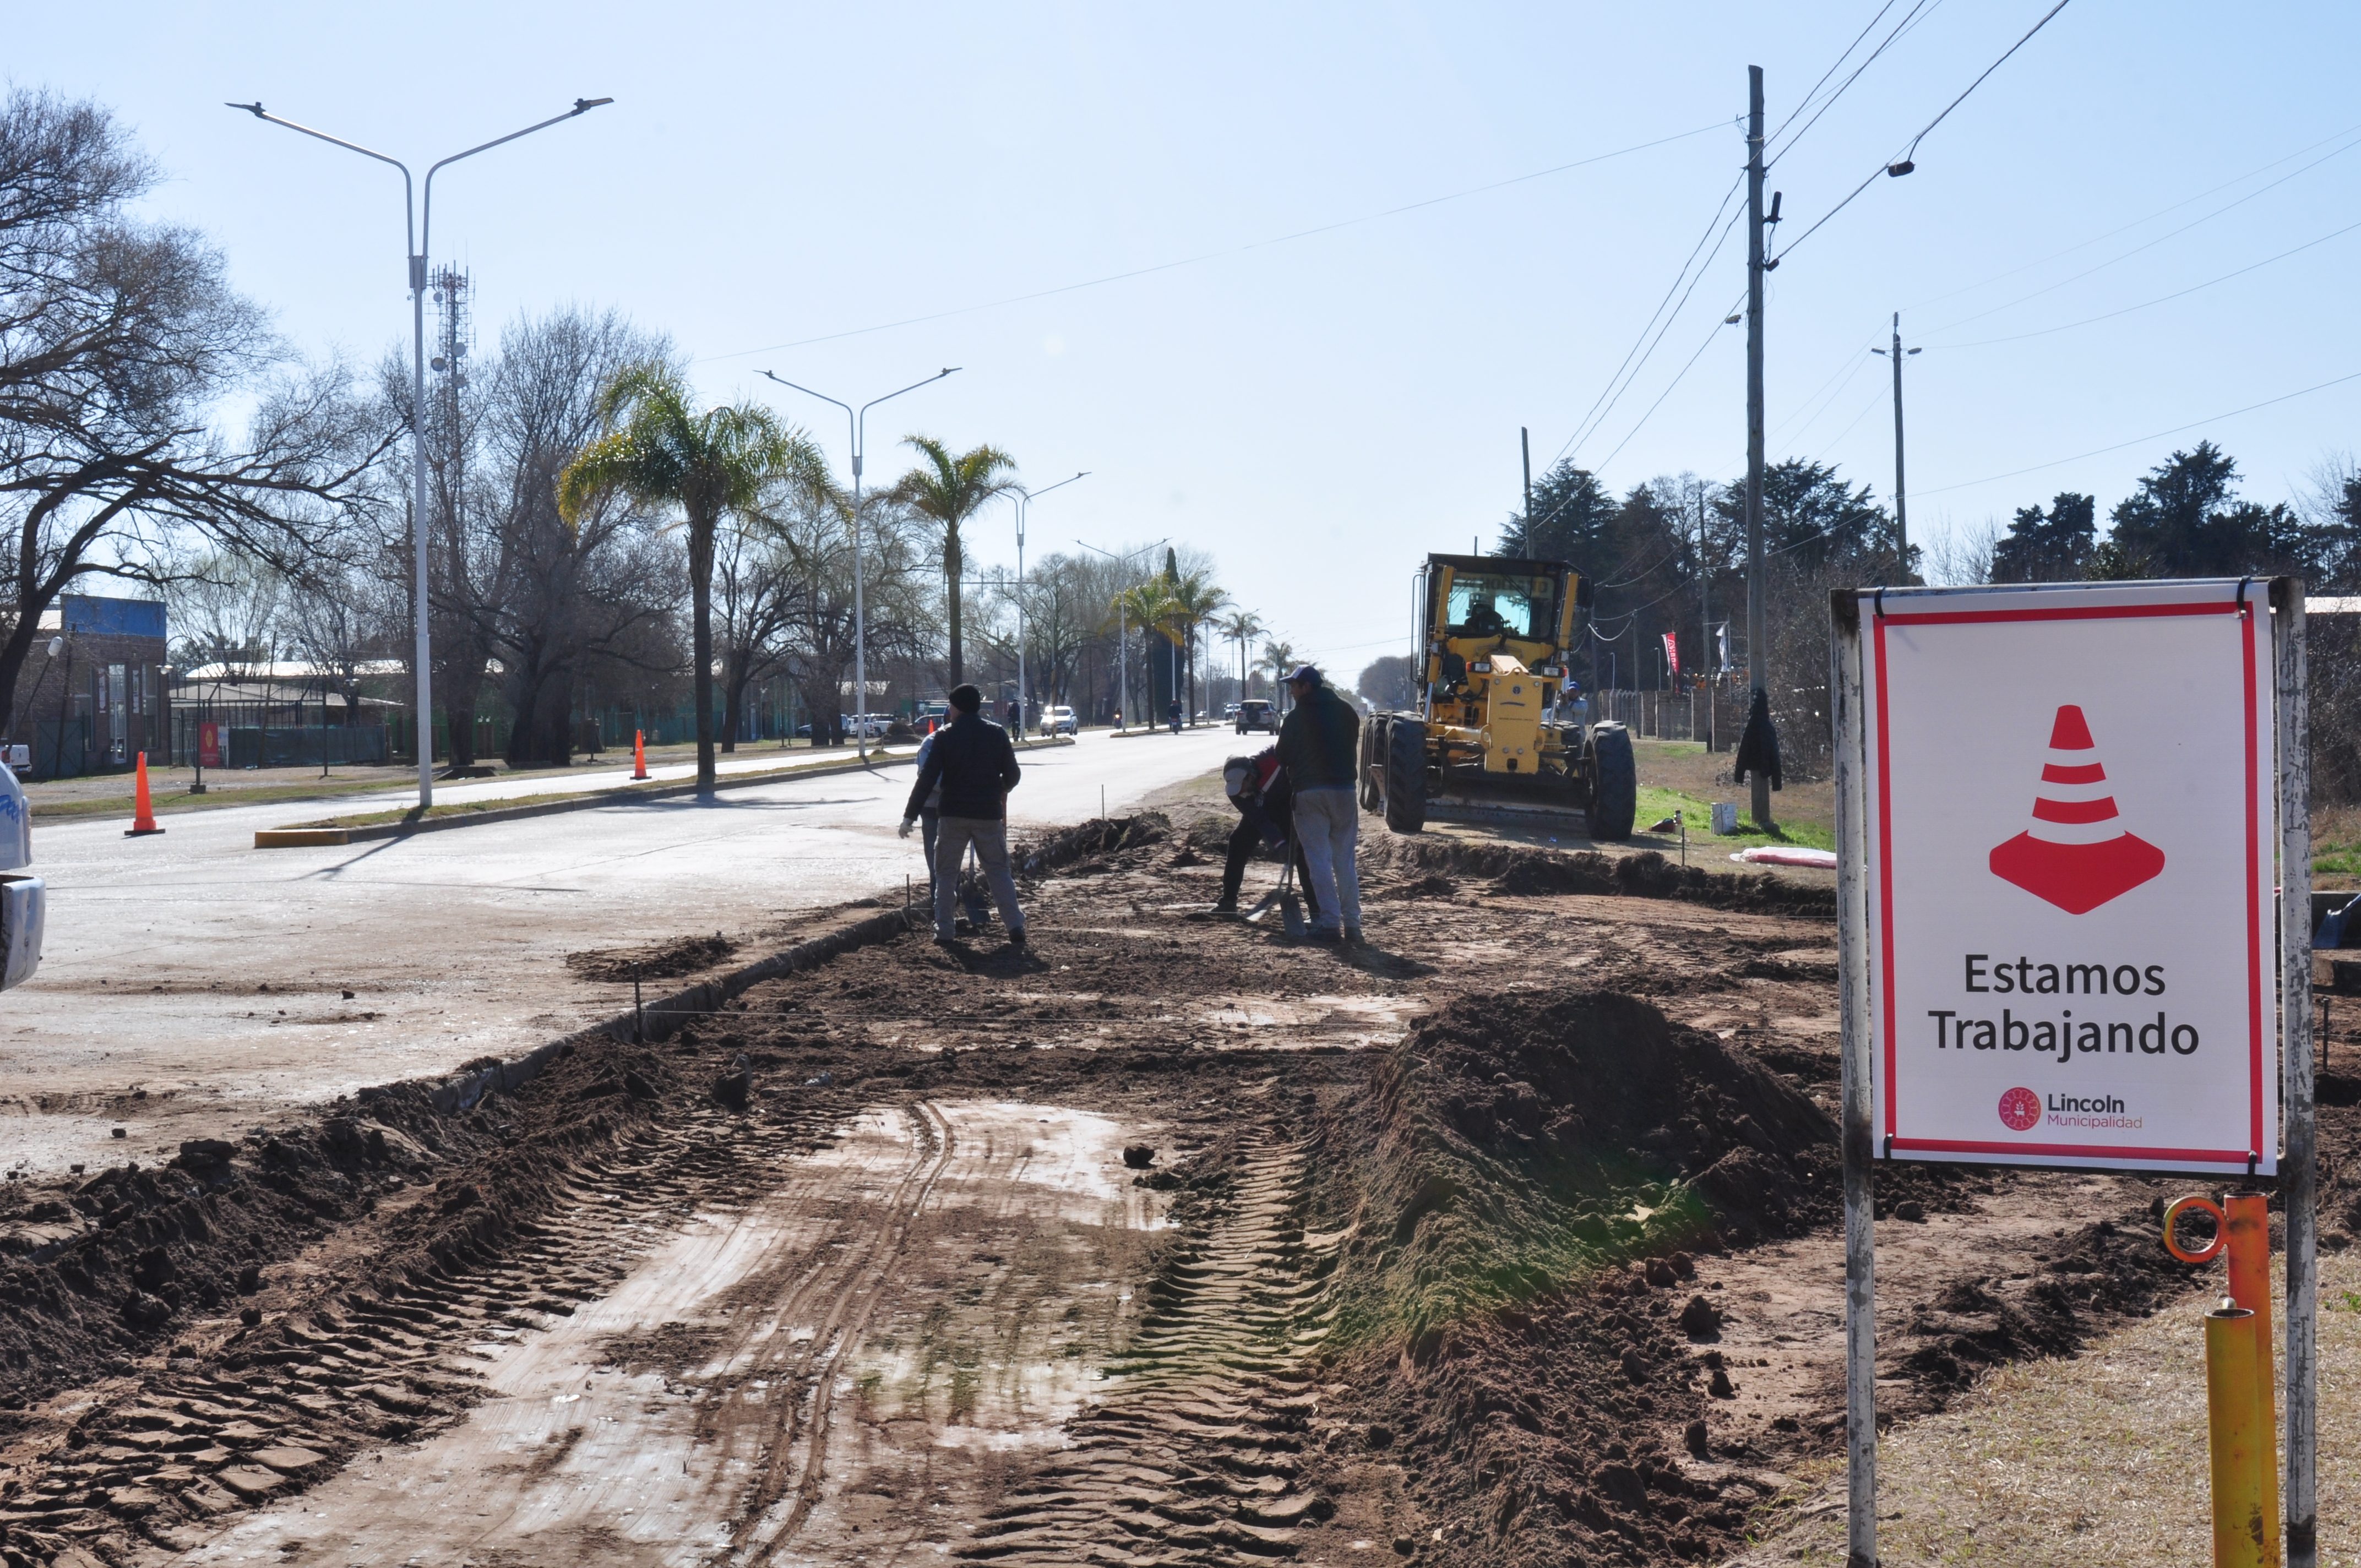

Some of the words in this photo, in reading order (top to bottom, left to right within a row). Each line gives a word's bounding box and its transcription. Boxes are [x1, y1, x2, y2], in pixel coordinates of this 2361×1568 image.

[1965, 954, 2166, 995] Estamos
[1928, 1009, 2199, 1063] Trabajando
[2048, 1093, 2125, 1113] Lincoln
[2048, 1114, 2142, 1129] Municipalidad
